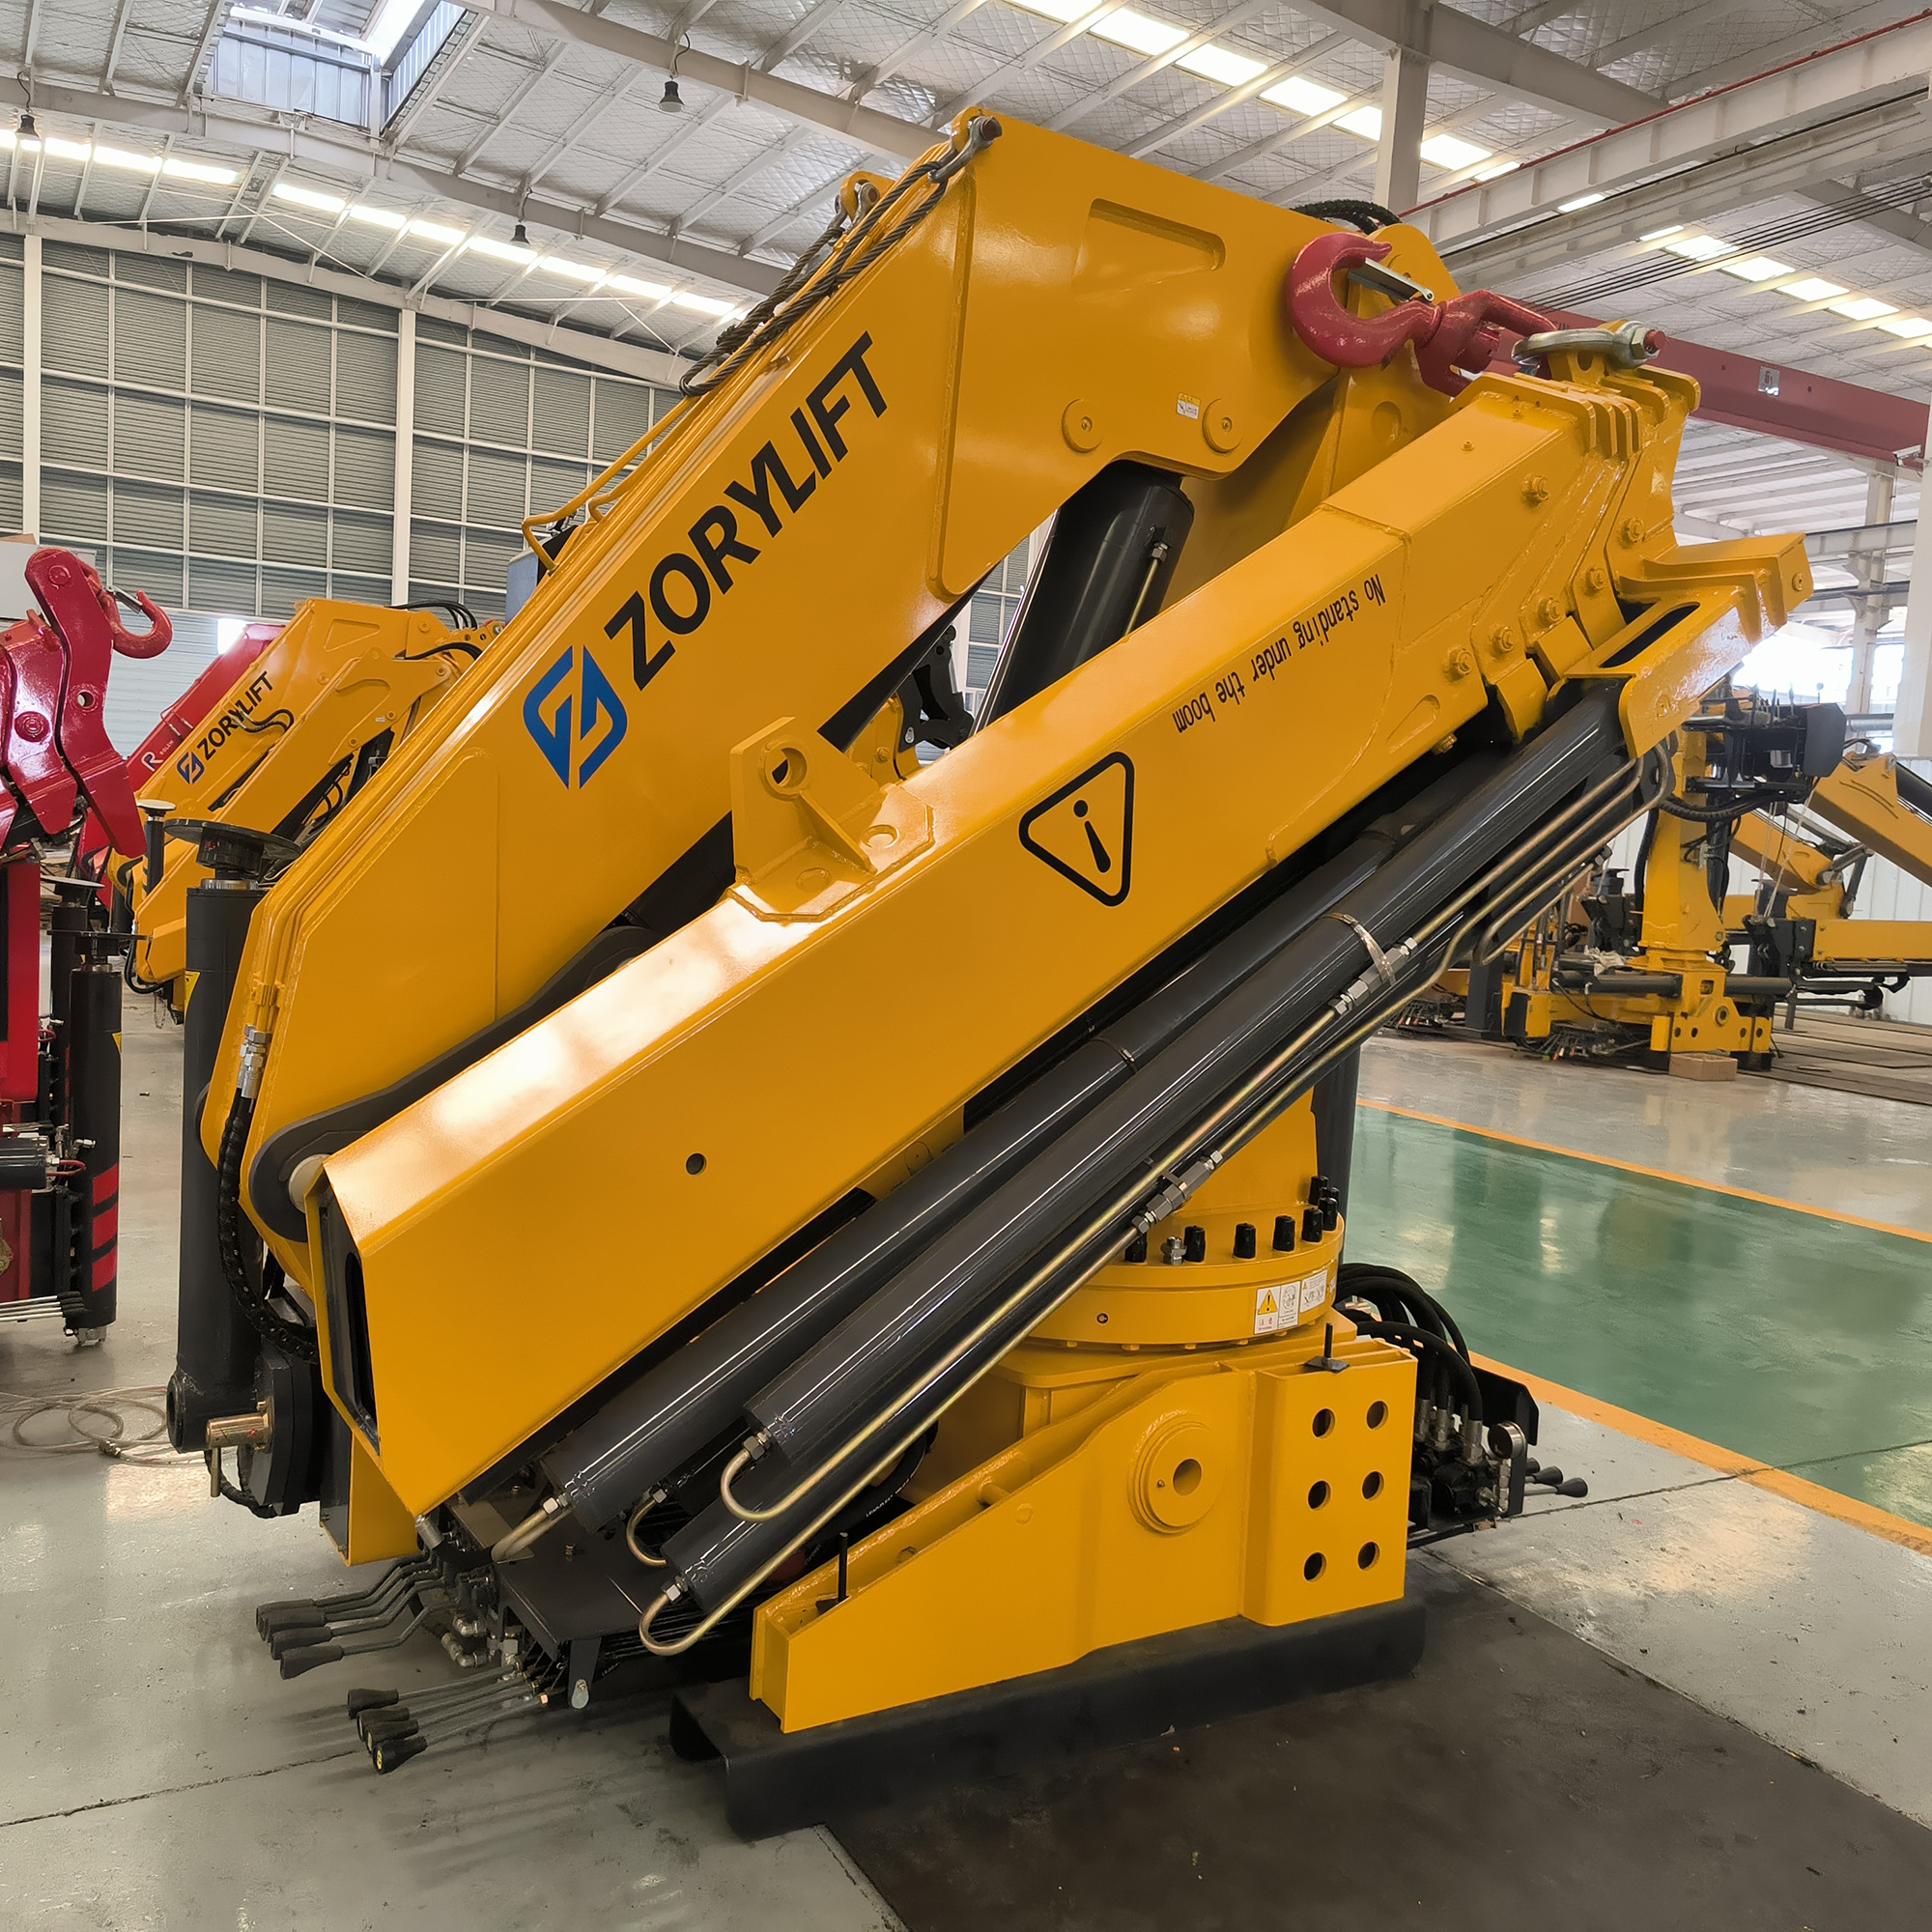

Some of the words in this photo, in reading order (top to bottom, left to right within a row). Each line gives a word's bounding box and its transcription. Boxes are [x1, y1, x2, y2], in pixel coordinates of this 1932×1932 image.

[604, 330, 888, 691] ZORYLIFT
[1363, 574, 1386, 607] No
[1293, 589, 1360, 650] standing
[1250, 637, 1293, 682] under
[1214, 670, 1246, 705] the
[197, 670, 272, 760] ZORYLIFT
[1172, 692, 1216, 733] boom
